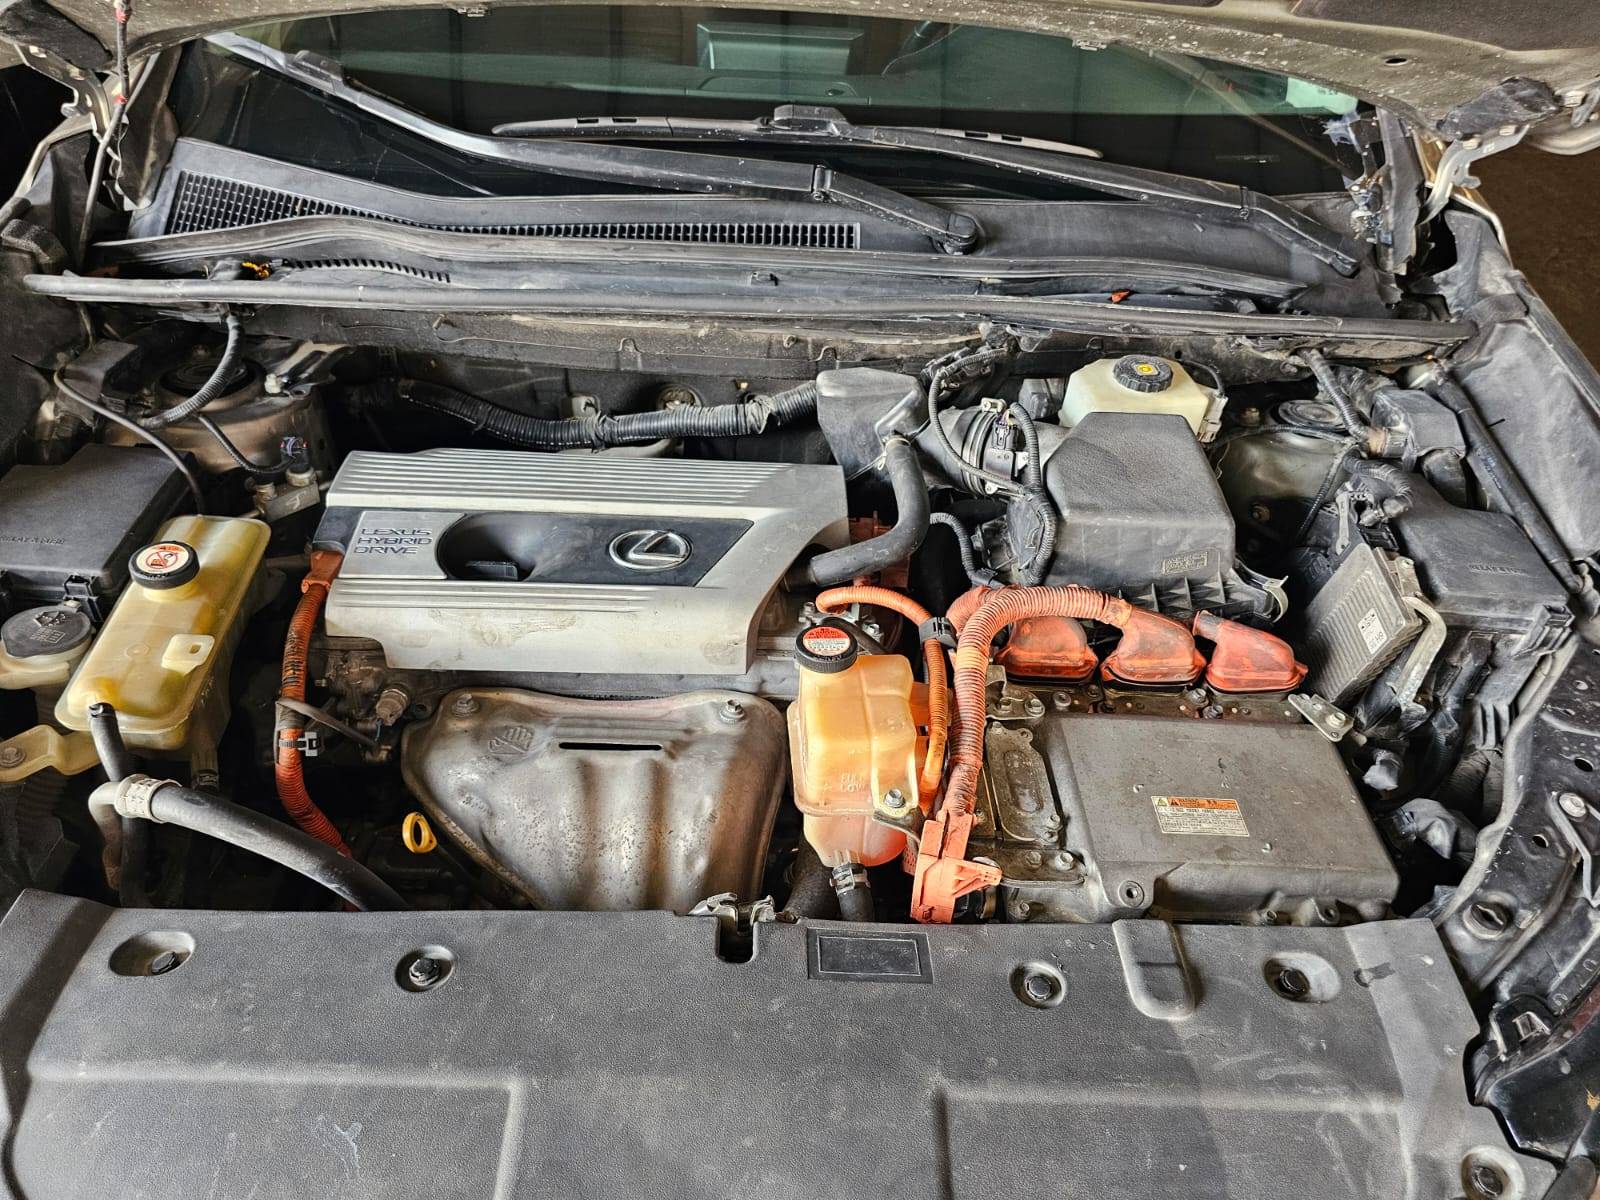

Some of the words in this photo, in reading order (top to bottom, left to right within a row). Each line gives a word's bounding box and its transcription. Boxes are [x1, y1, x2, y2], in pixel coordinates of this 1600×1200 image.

[361, 528, 432, 536] LEXUS
[357, 537, 432, 545] HYBRID
[353, 546, 418, 554] DRIVE
